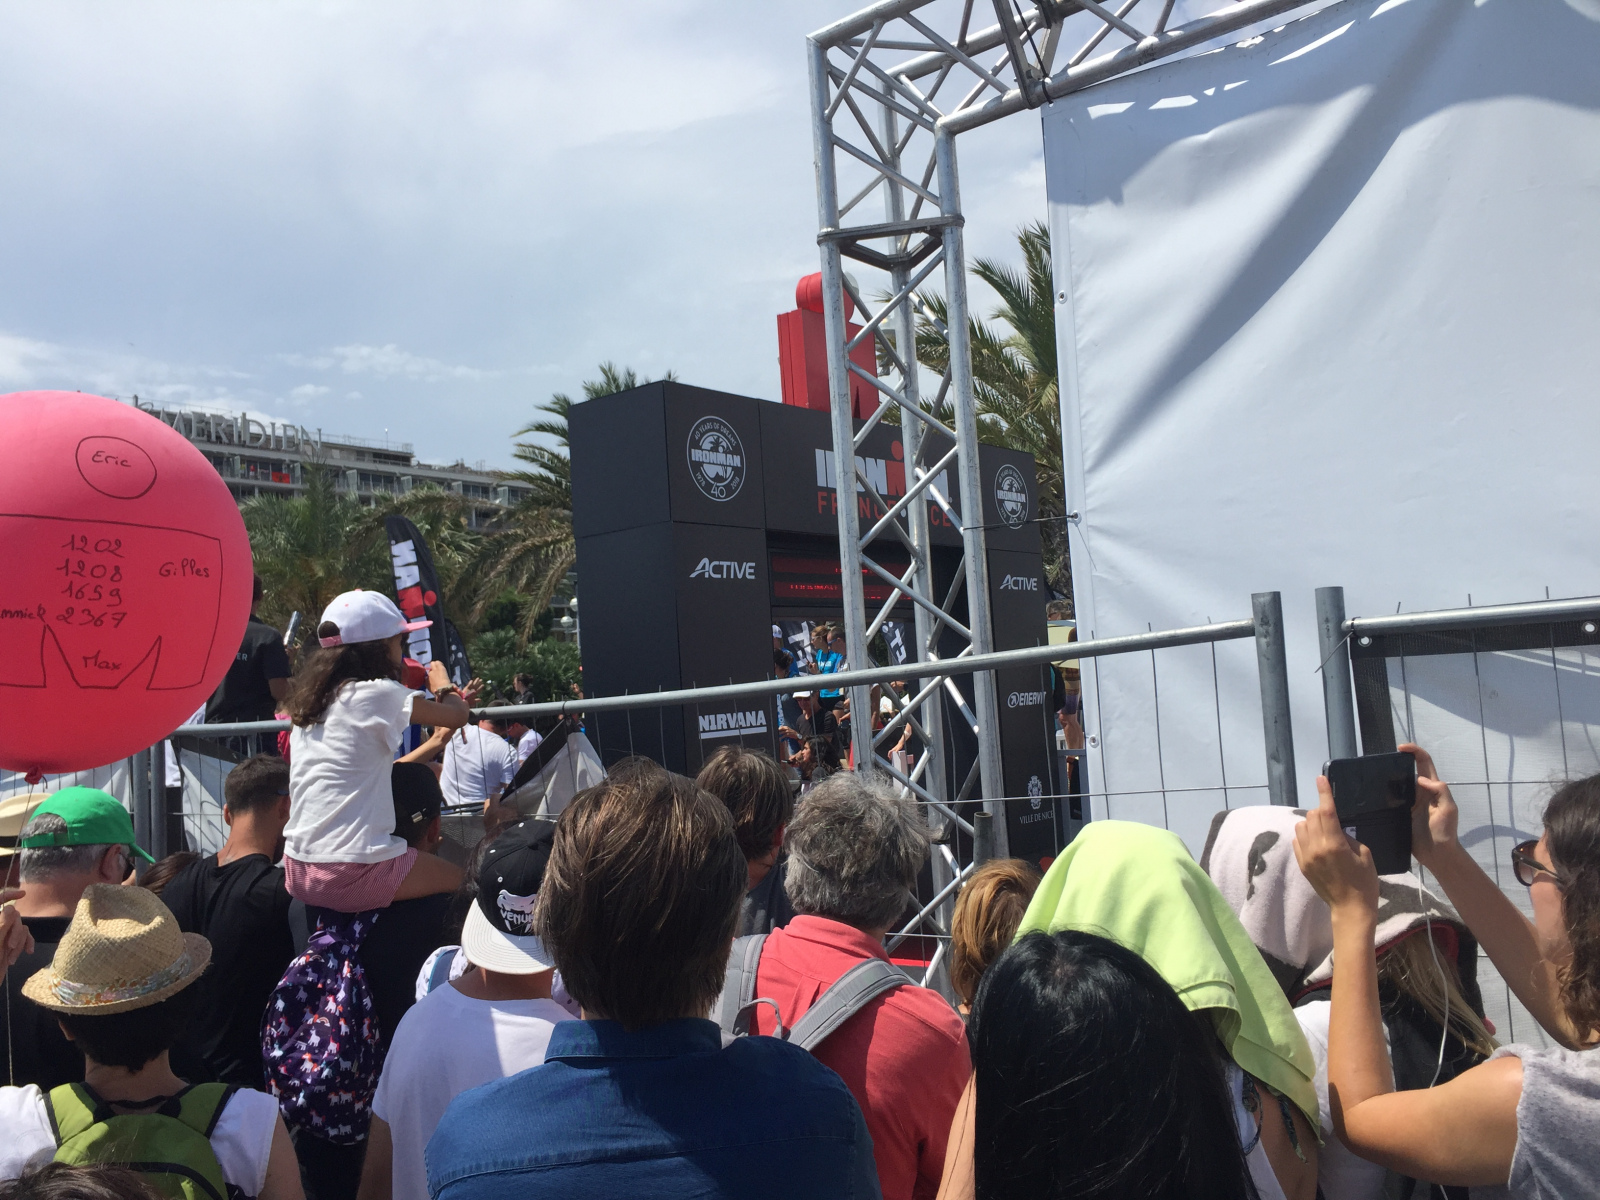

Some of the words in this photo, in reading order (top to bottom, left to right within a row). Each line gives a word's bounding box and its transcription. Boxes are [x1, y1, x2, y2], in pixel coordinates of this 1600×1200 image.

[91, 450, 131, 468] Eric
[691, 448, 742, 468] IRONMAN
[710, 482, 727, 498] 40
[61, 534, 125, 558] 1202
[56, 558, 123, 583] 1208
[689, 557, 756, 580] ACTIVE
[61, 580, 122, 607] 1659
[1000, 574, 1038, 591] ACTIVE
[56, 606, 127, 628] 2367
[82, 649, 122, 672] Max
[698, 710, 767, 732] NIRVANA
[1019, 814, 1034, 824] VILLE
[1034, 813, 1042, 822] DE
[1042, 810, 1054, 820] NICE
